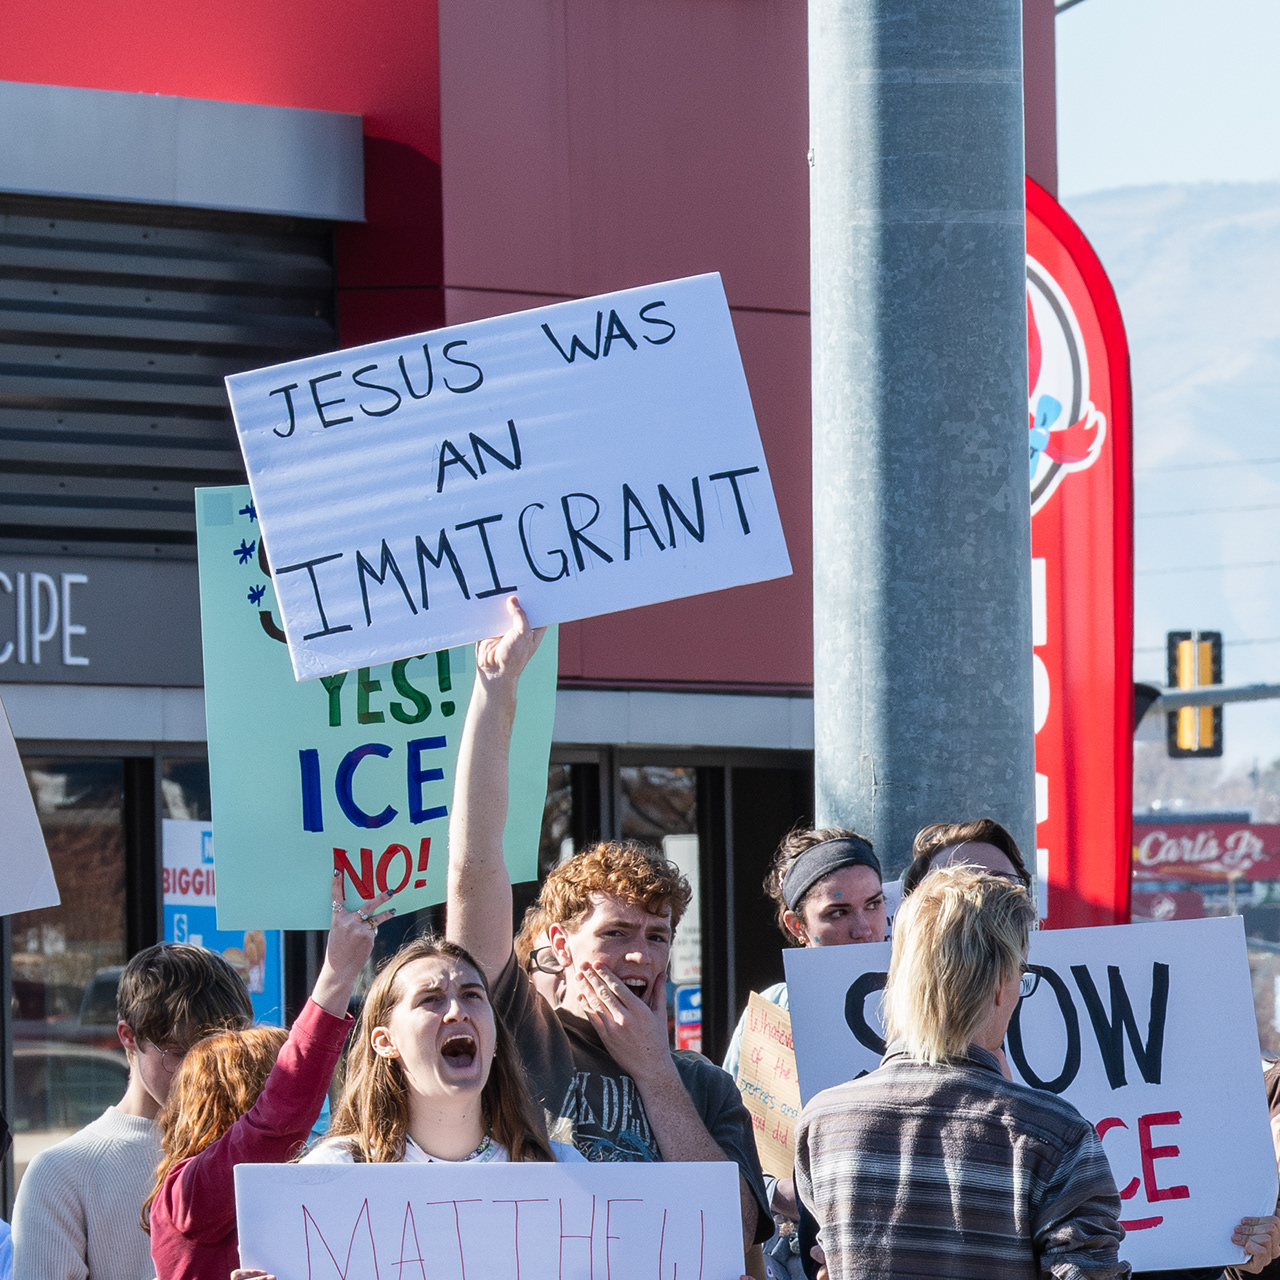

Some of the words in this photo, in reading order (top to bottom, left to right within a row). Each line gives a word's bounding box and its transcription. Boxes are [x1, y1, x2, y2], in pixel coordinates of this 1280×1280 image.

[270, 341, 485, 438] JESUS
[541, 301, 677, 364] WAS
[436, 419, 521, 493] AN
[276, 466, 760, 641] IMMIGRANT
[320, 650, 456, 727] YES!
[299, 735, 449, 833] ICE
[163, 866, 216, 897] BIGGI
[332, 837, 432, 901] NO!
